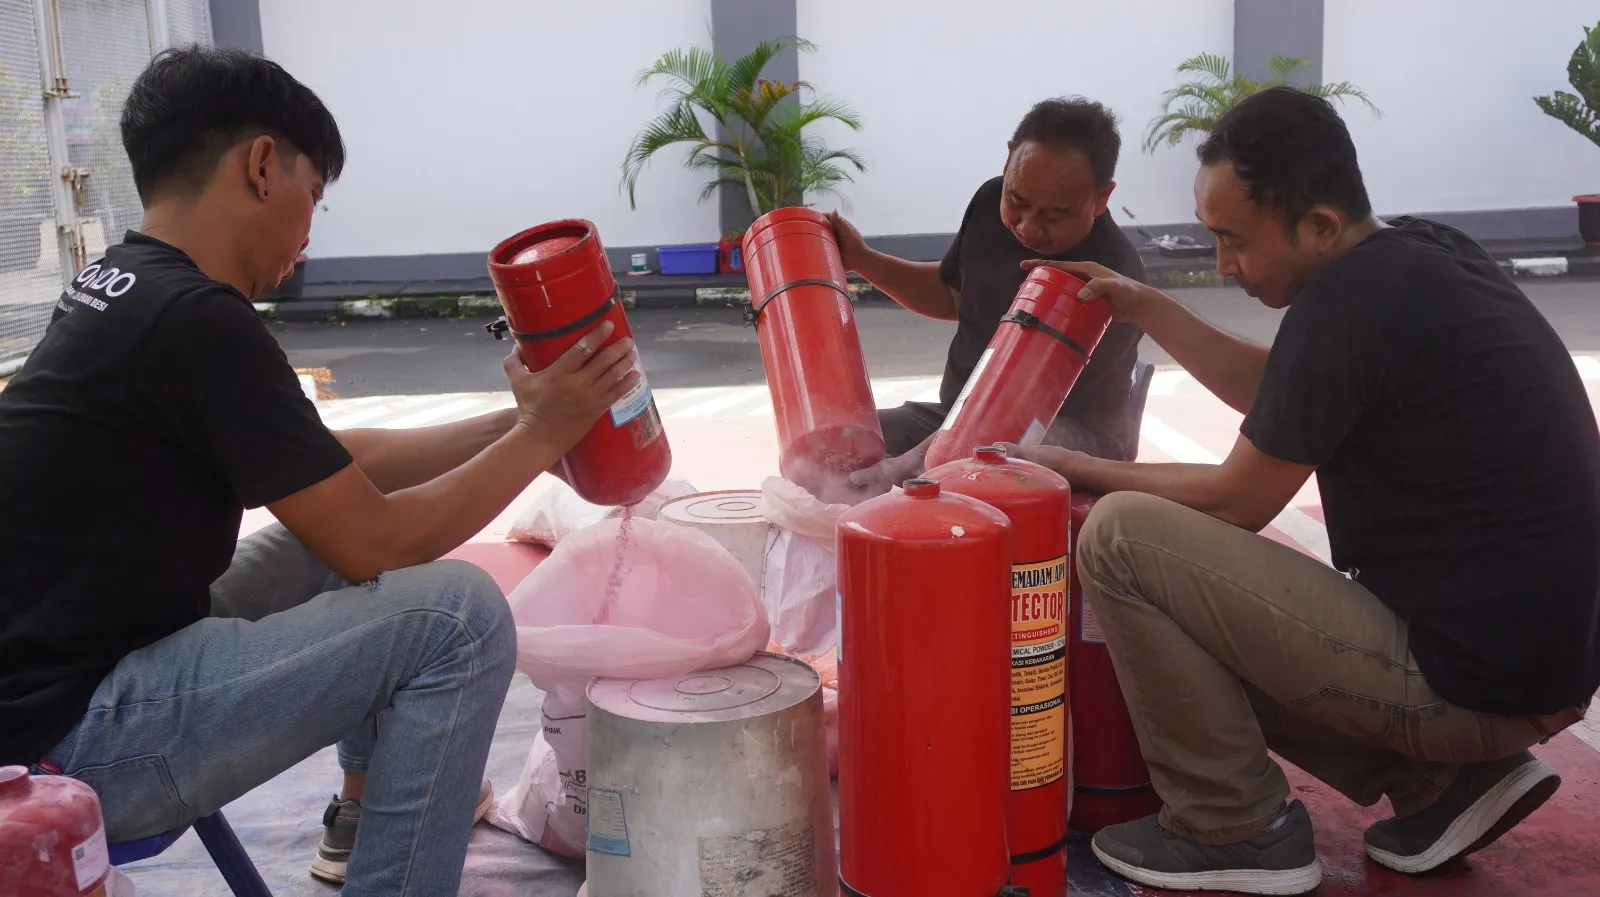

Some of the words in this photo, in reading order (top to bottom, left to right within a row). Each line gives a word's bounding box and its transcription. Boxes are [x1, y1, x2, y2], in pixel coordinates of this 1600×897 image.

[90, 298, 108, 312] BESI
[1012, 567, 1052, 588] EMADAM
[1054, 562, 1065, 582] API
[1012, 592, 1063, 623] TECTOR
[1033, 642, 1054, 653] POWDER
[1025, 654, 1055, 666] KEBAKARAN
[1020, 697, 1062, 714] OPERASIONAL
[544, 726, 562, 735] PINK
